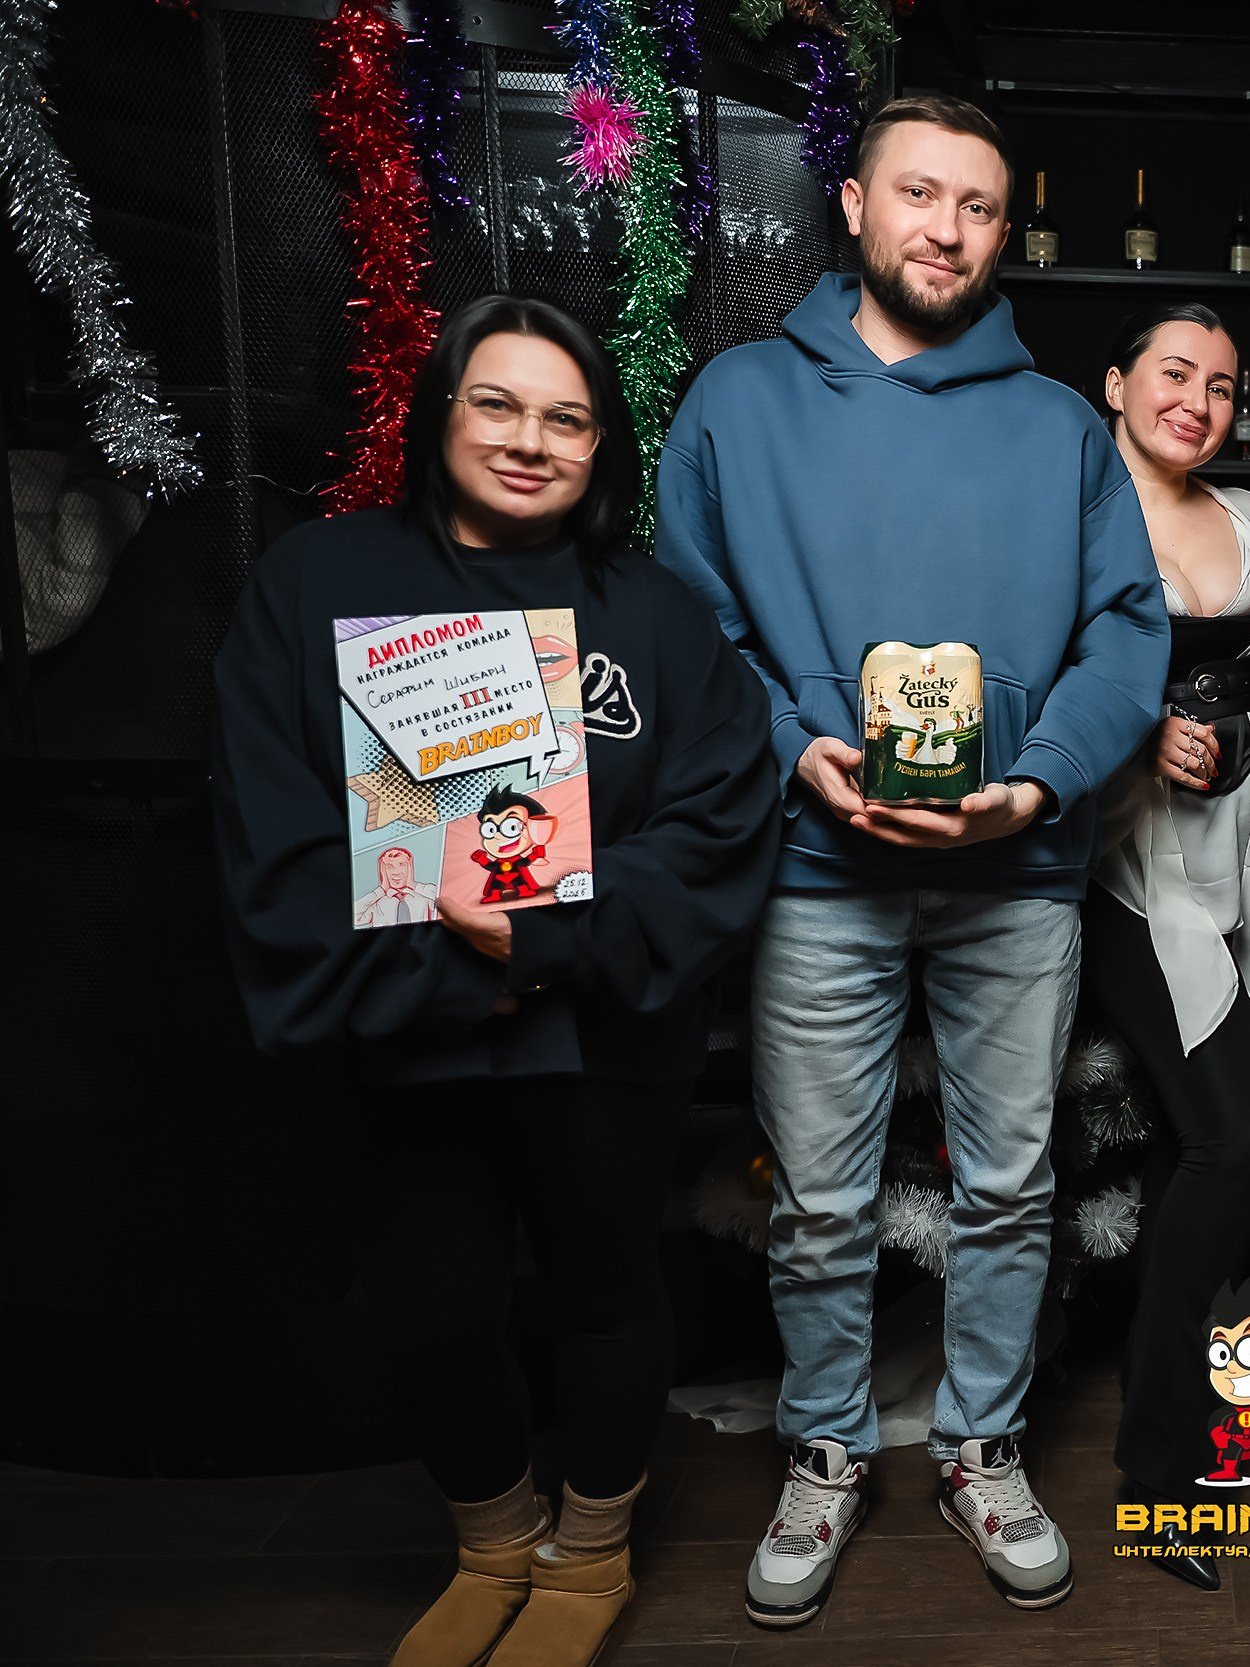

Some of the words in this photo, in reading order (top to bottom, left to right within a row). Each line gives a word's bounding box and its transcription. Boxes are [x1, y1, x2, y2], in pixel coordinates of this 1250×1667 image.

[357, 648, 449, 684] НАГРАЖДАЕТСЯ
[457, 628, 511, 651] КОМАНДА
[368, 614, 484, 668] ДИПЛОМОМ
[388, 703, 459, 731] ЗАНЯВШАЯ
[459, 686, 493, 709] III
[494, 680, 533, 698] МЕСТО
[898, 673, 958, 695] Žatecký
[906, 690, 950, 708] Gus
[435, 701, 514, 732] СОСТЯЗАНИИ
[417, 712, 543, 776] BRAINBOY
